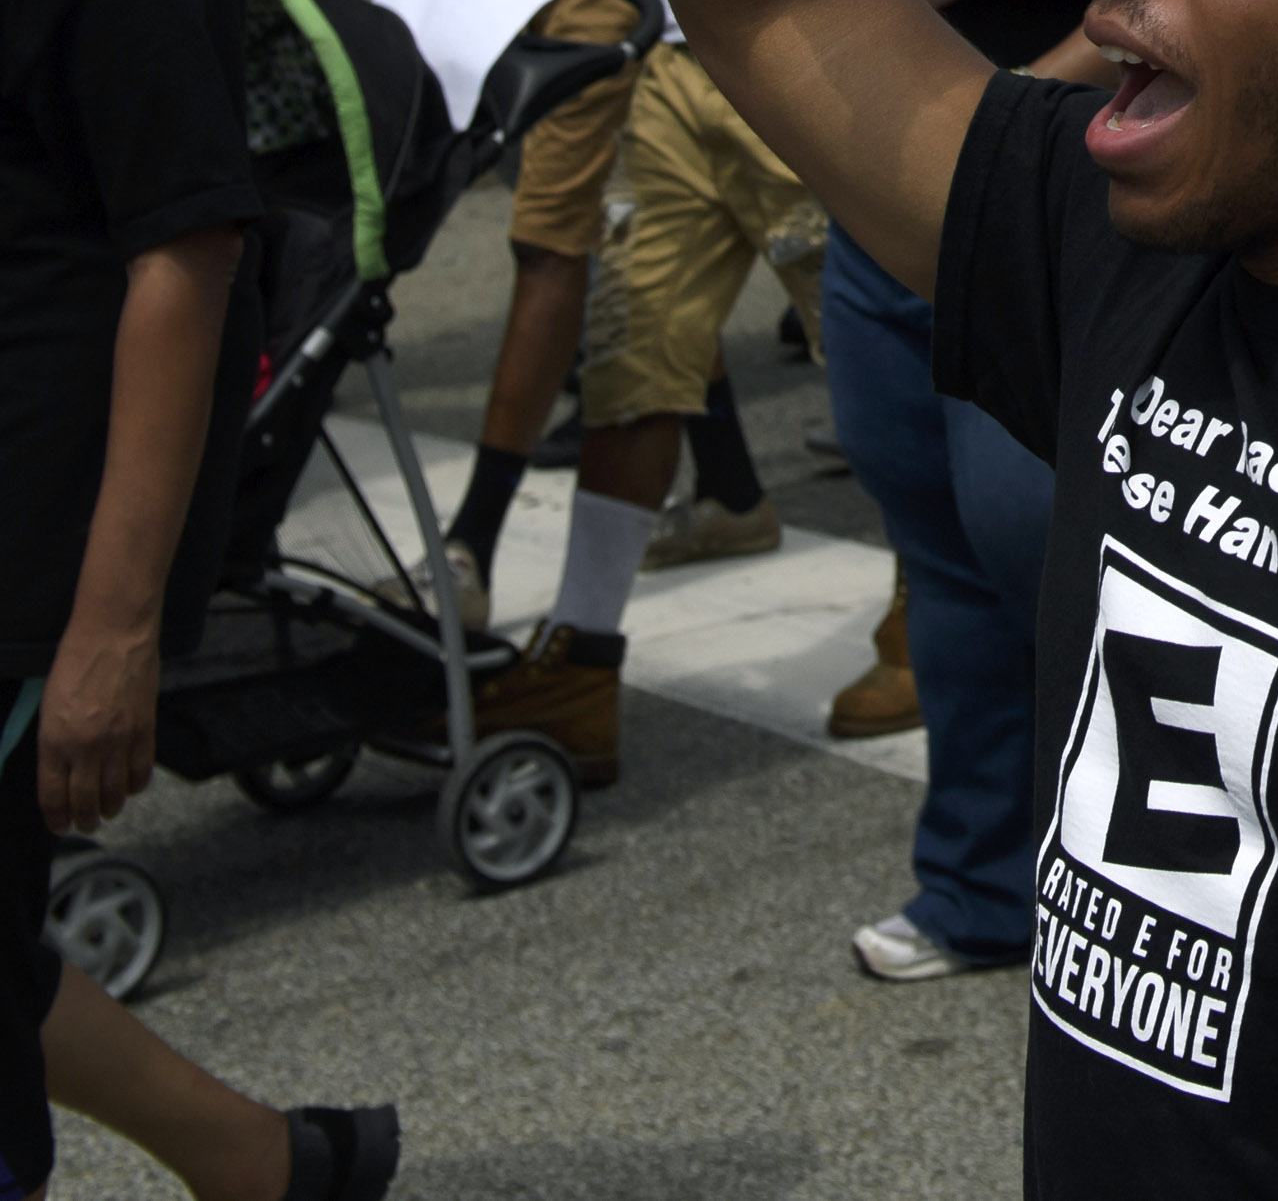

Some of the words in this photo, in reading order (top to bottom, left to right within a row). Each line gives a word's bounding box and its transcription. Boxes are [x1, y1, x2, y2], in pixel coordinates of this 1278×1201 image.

[1097, 387, 1176, 524] Tese
[1131, 375, 1234, 458] Dear
[1101, 628, 1242, 876] E
[1034, 901, 1228, 1070] EVERYONE
[1042, 857, 1122, 941] RATED
[1132, 915, 1158, 960] E
[1165, 929, 1234, 993] FOR
